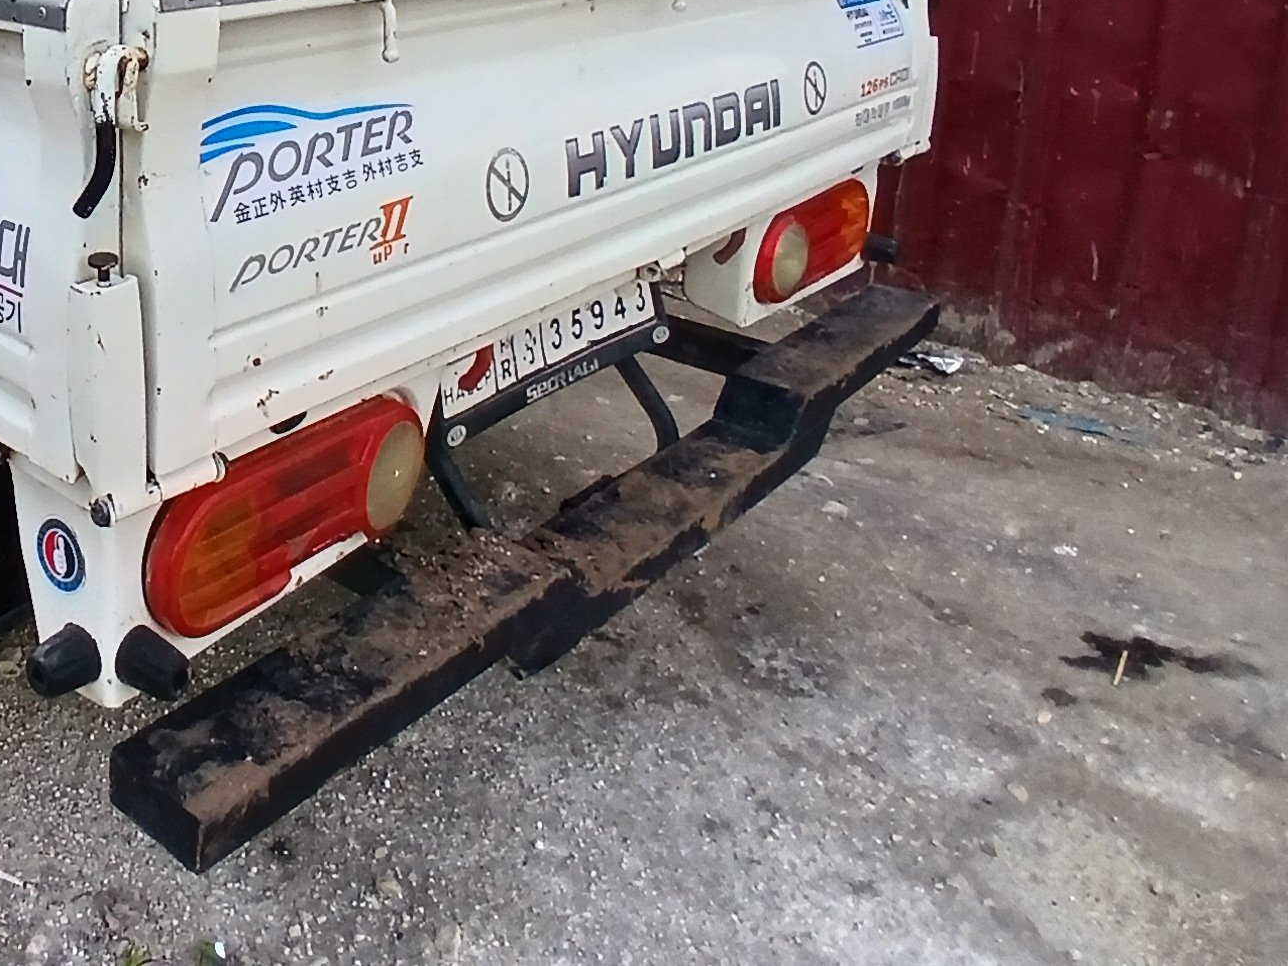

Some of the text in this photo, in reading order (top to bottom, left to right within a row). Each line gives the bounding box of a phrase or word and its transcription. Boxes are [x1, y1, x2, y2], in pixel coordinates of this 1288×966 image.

[210, 110, 413, 223] PORTER
[565, 79, 781, 198] HYUNDAI
[229, 217, 382, 293] PORTER
[549, 282, 646, 350] 35943
